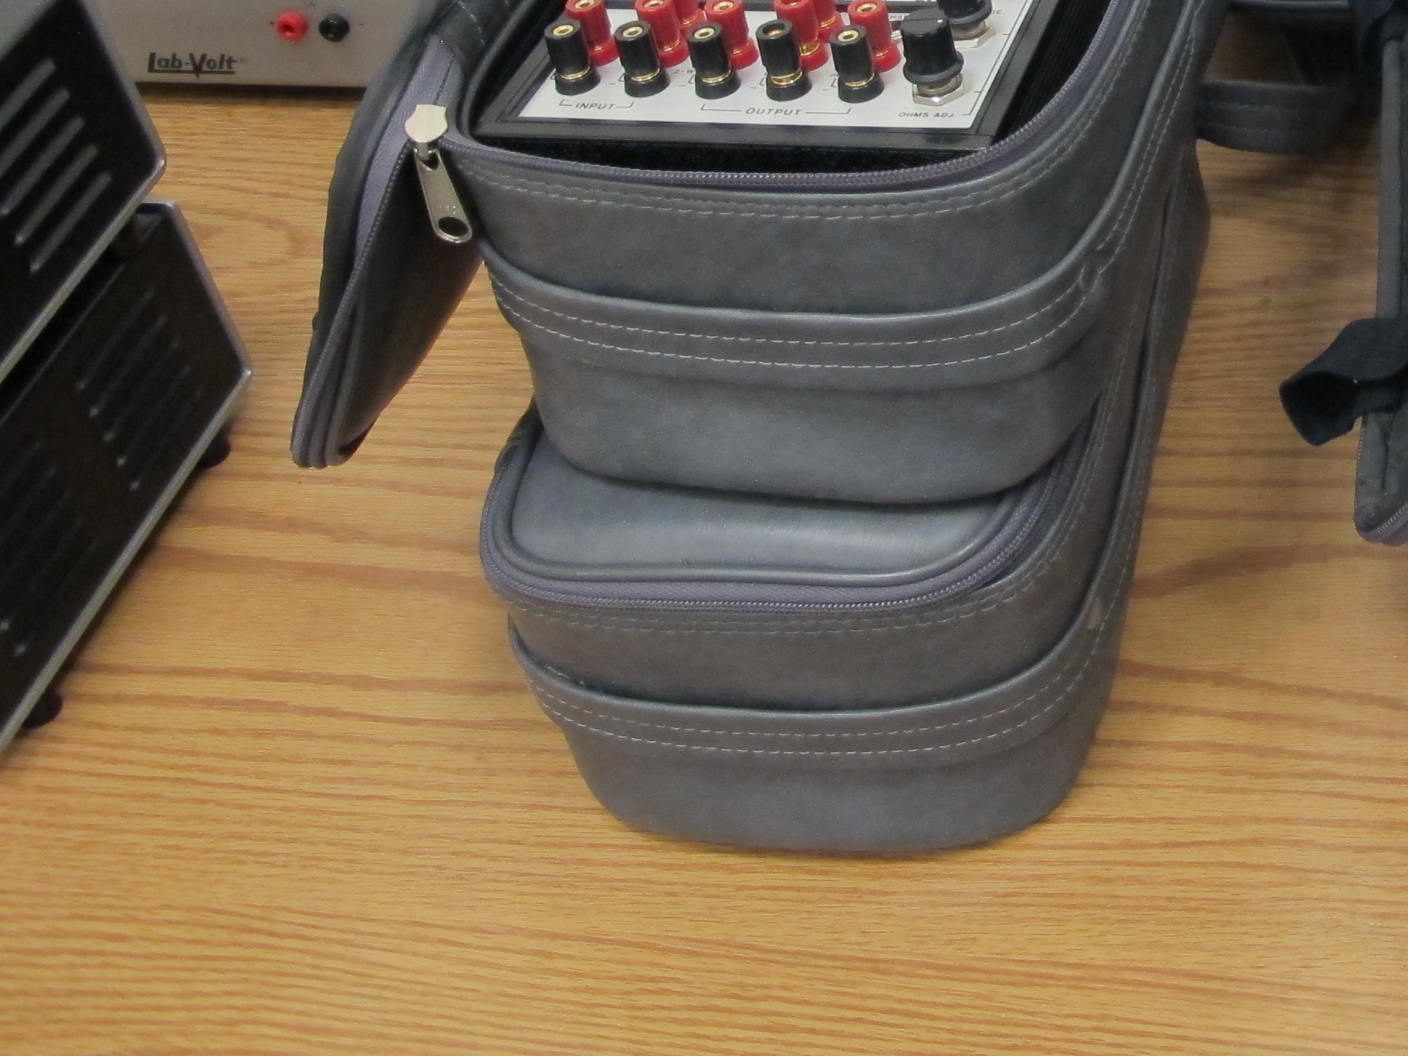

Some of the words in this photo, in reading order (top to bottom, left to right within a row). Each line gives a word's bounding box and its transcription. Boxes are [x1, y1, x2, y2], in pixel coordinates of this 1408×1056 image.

[147, 51, 238, 78] Lab-Volt
[575, 102, 616, 110] INPUT
[744, 107, 802, 116] OUTPUT
